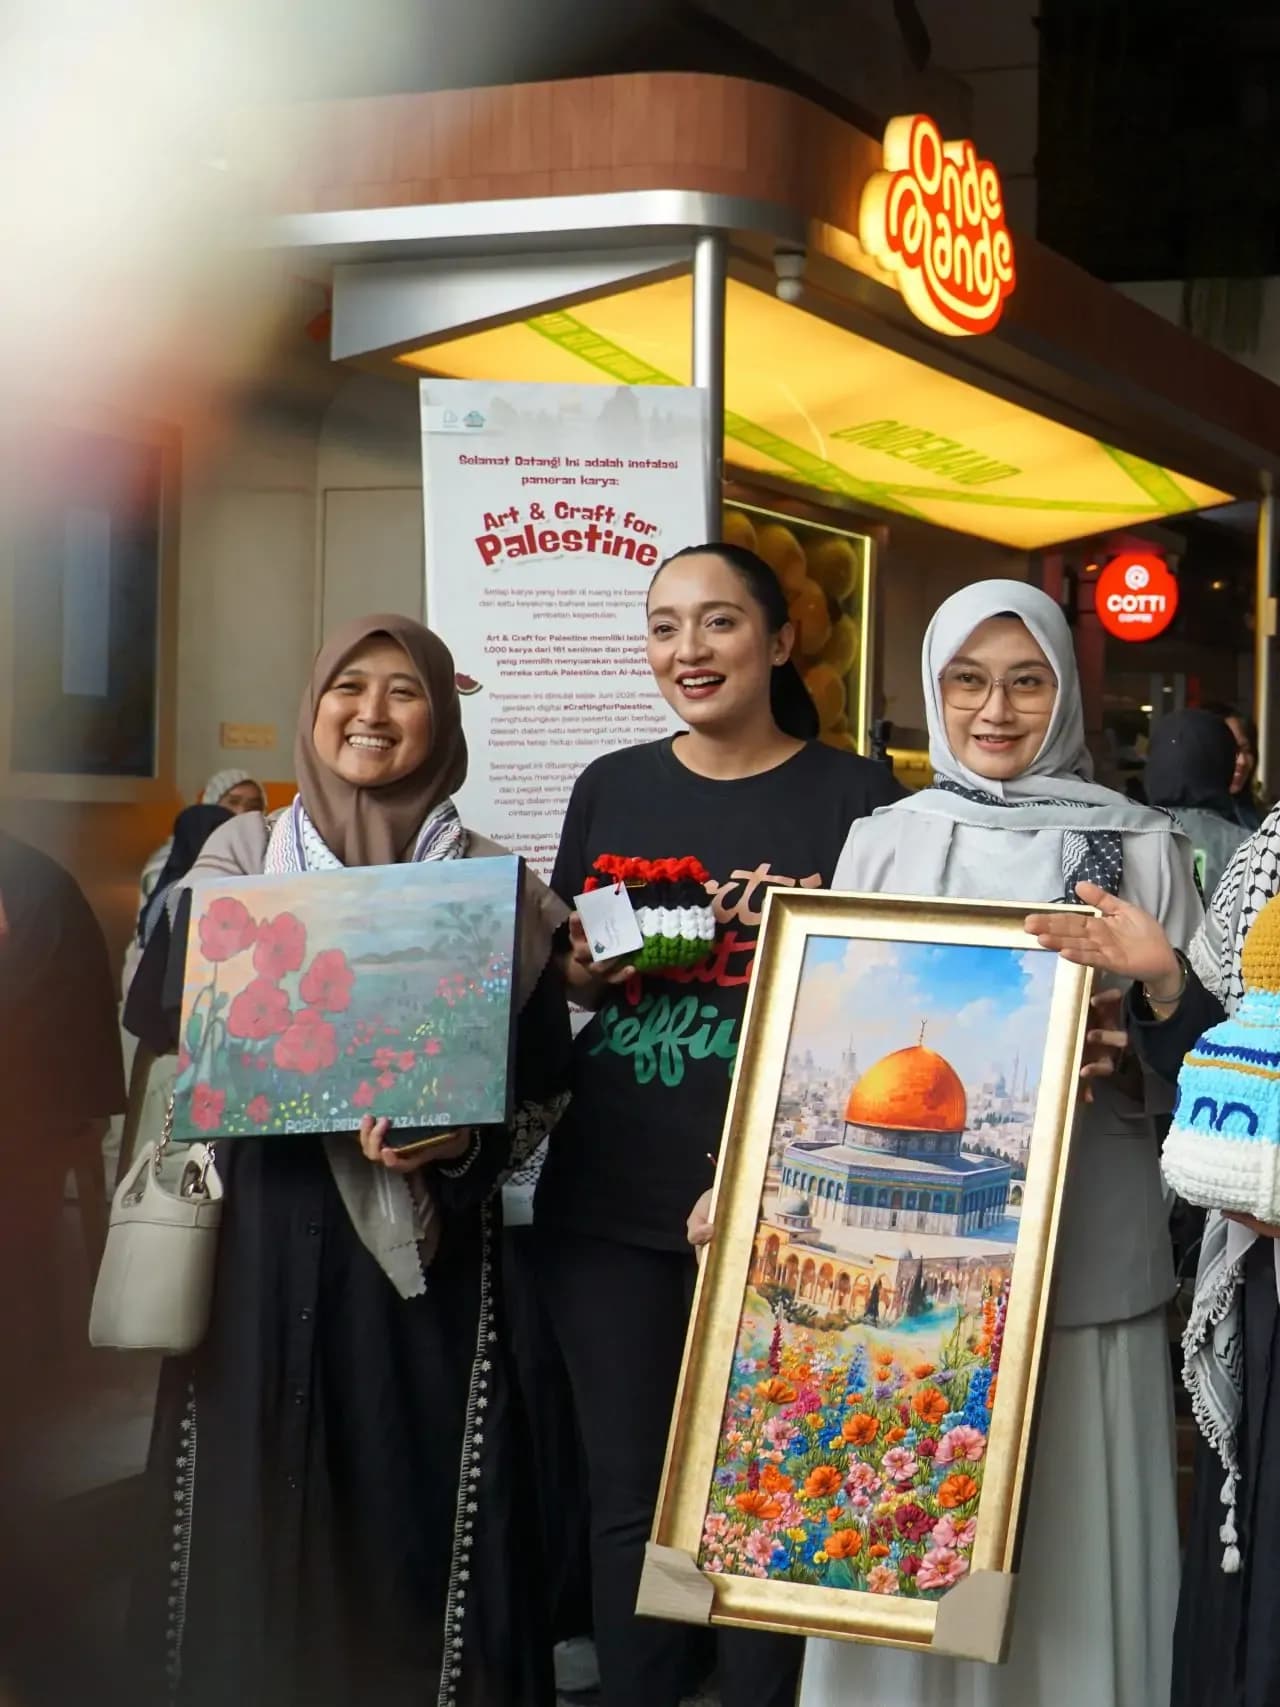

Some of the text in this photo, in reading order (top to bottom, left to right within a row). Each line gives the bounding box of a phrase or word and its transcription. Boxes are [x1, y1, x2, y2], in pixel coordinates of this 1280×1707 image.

[913, 120, 1001, 226] Onde
[458, 454, 510, 466] Selamat
[565, 456, 580, 468] Ini
[584, 457, 624, 469] adalah
[628, 459, 678, 469] instalasi
[521, 474, 620, 488] pameran karya:
[483, 501, 658, 536] Art & Craft for
[475, 524, 659, 567] Palestine
[1106, 594, 1166, 613] COTTI
[534, 844, 559, 852] gerak
[388, 1115, 417, 1128] AZA
